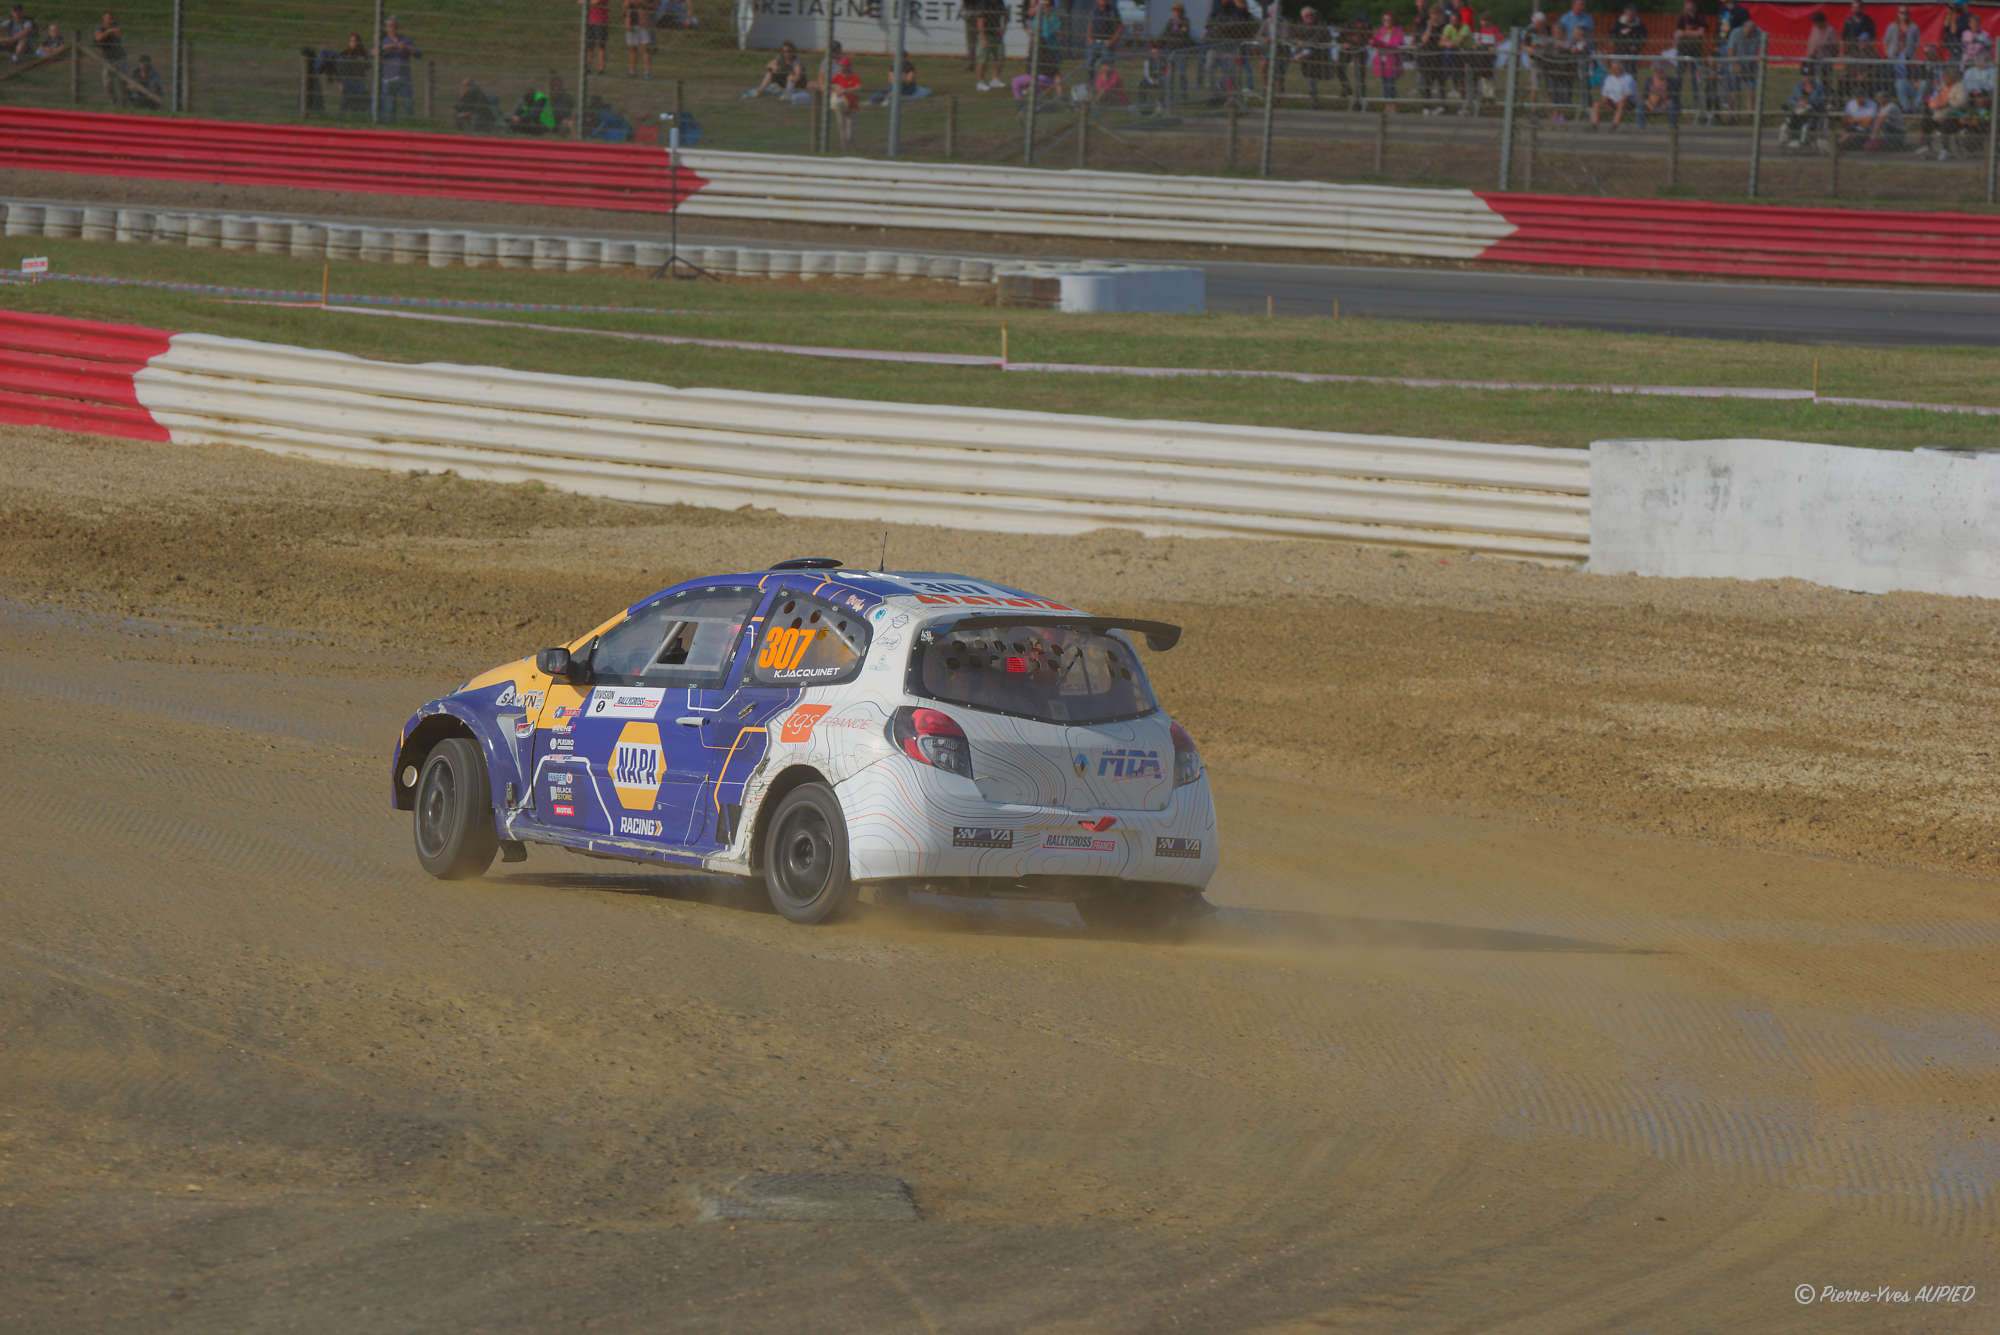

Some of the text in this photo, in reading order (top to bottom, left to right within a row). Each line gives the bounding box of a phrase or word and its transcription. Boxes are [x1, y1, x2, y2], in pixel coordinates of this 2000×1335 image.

[758, 626, 816, 670] 307
[774, 667, 840, 678] K.JACQUINET
[594, 690, 615, 699] DIVISION
[821, 717, 872, 730] FRANCE
[617, 747, 656, 785] NAPA
[620, 816, 655, 835] RACING
[1046, 834, 1093, 848] RALLYCROSS
